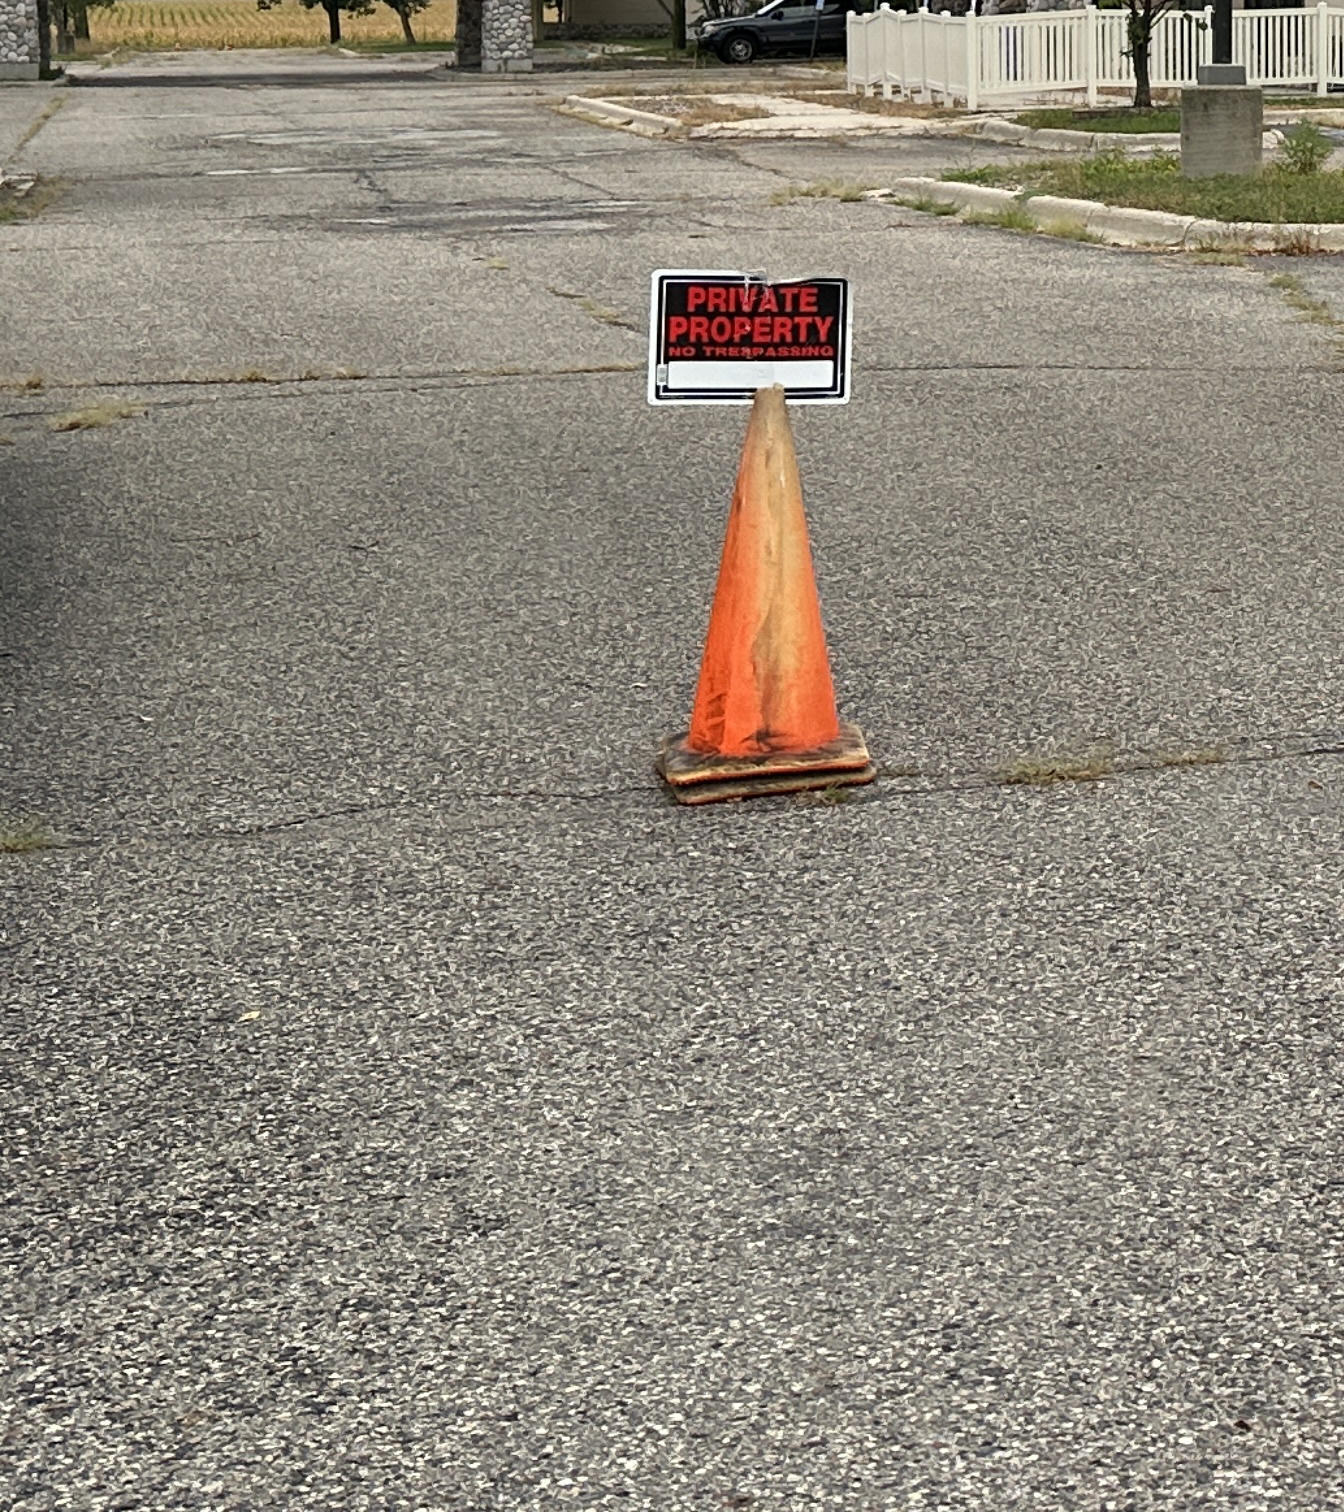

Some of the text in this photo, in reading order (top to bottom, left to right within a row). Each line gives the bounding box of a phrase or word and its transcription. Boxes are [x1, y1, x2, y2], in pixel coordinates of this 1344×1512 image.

[687, 287, 818, 312] PRIVATE
[668, 316, 835, 343] PROPERTY
[668, 345, 835, 357] NO TRESPASSING
